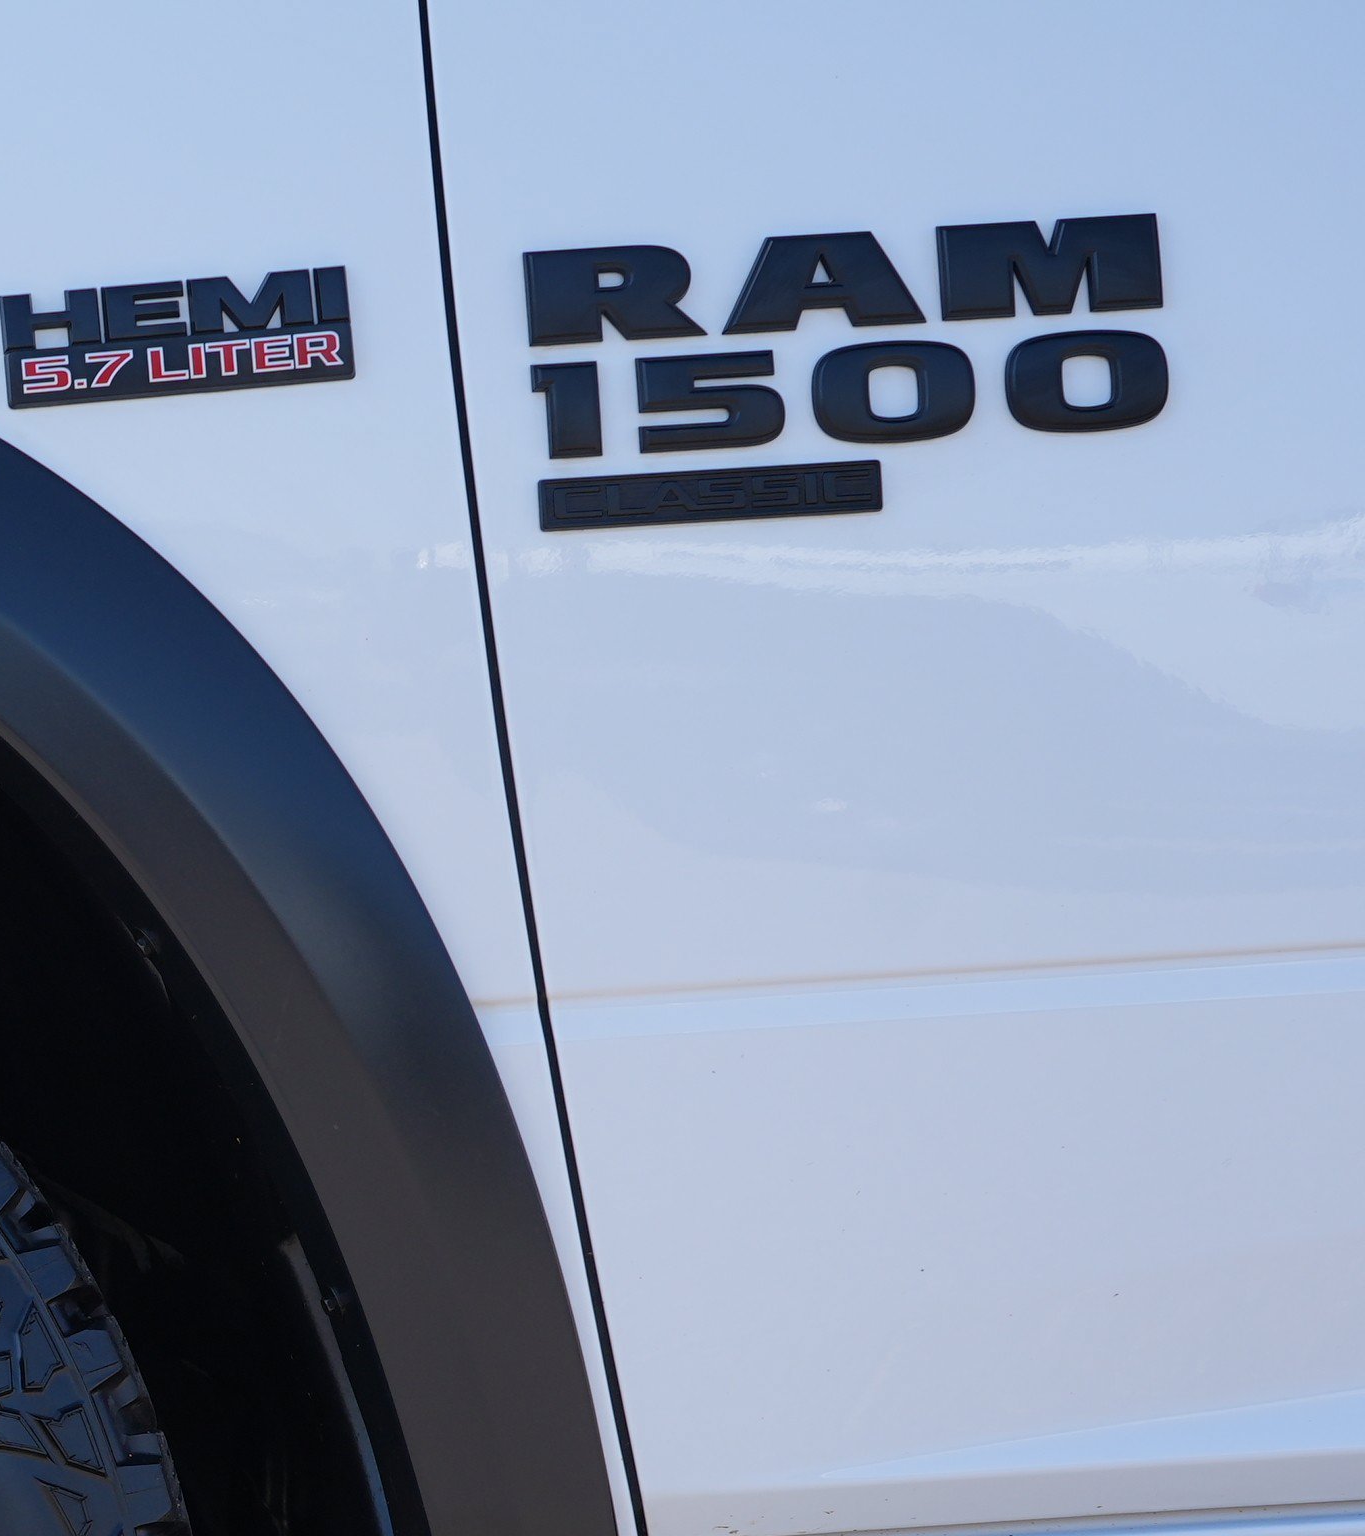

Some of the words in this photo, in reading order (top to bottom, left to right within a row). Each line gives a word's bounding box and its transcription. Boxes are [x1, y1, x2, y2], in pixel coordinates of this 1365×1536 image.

[522, 213, 1164, 346] RAM
[21, 349, 134, 394] 5.7
[147, 331, 345, 383] LITER
[530, 329, 1169, 459] 1500
[553, 469, 875, 519] CLASSIC
